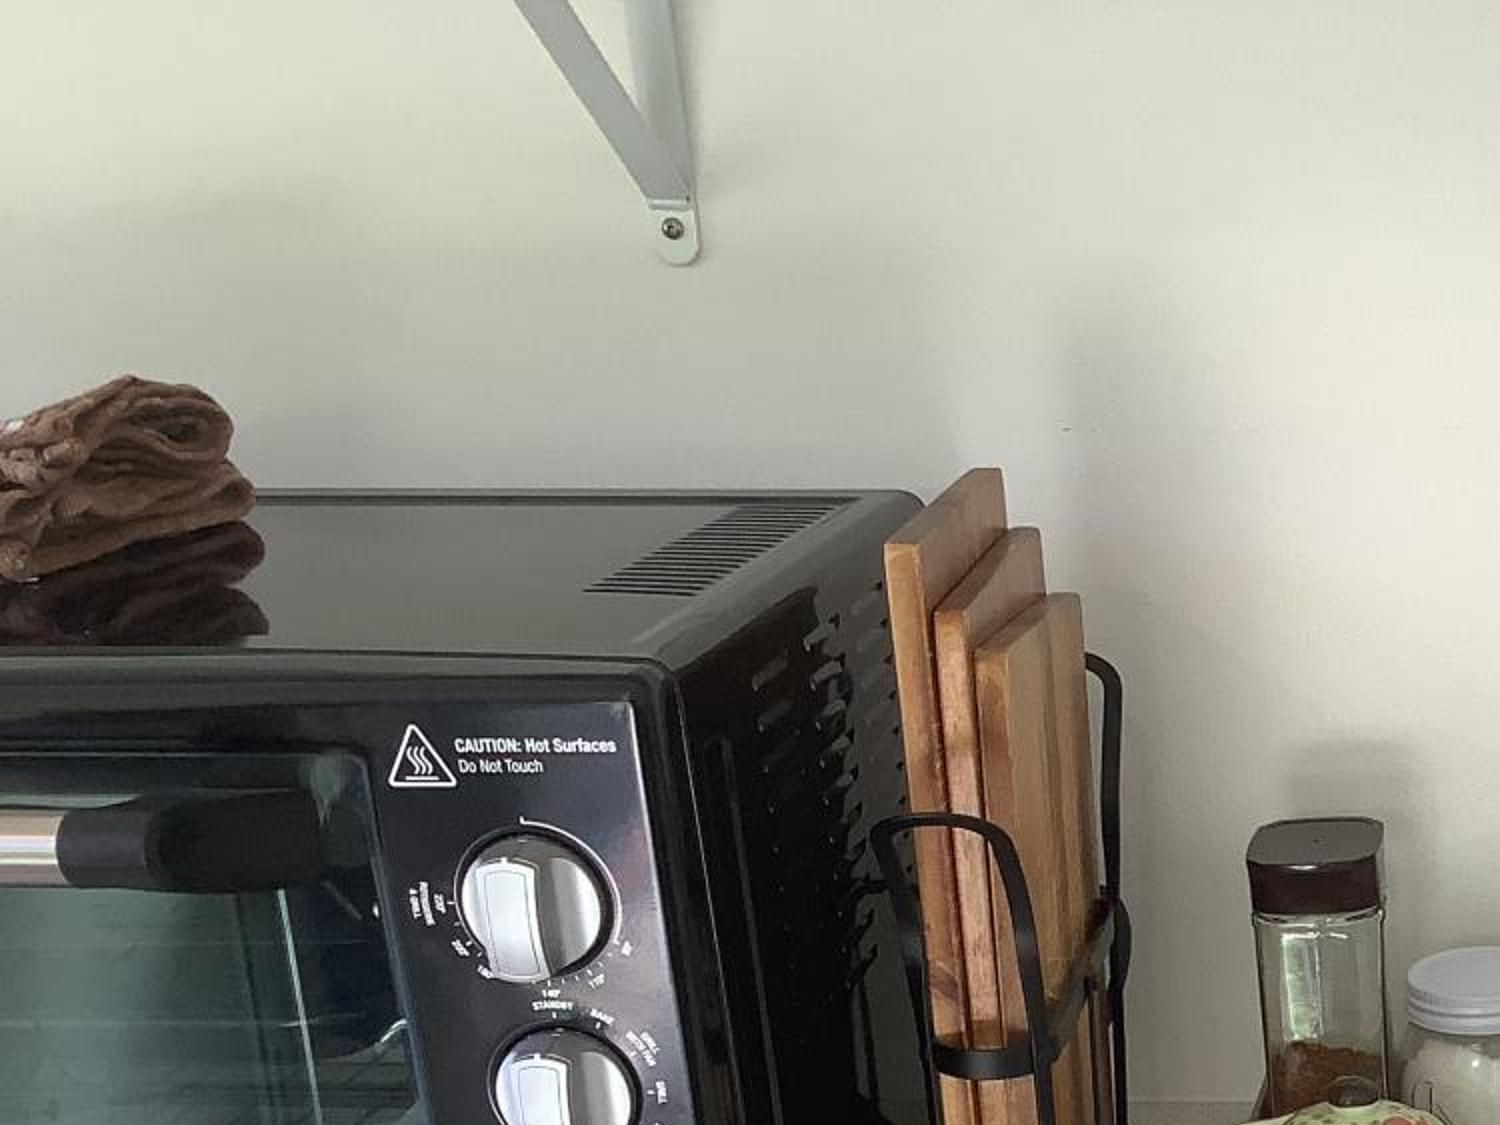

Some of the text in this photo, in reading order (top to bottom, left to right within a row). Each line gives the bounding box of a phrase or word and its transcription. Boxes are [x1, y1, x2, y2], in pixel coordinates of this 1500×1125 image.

[454, 737, 617, 753] CAUTION: Hot Surfaces
[459, 759, 544, 774] Do Not Touch
[532, 1001, 574, 1011] STANDBY
[590, 1008, 615, 1025] BAKE
